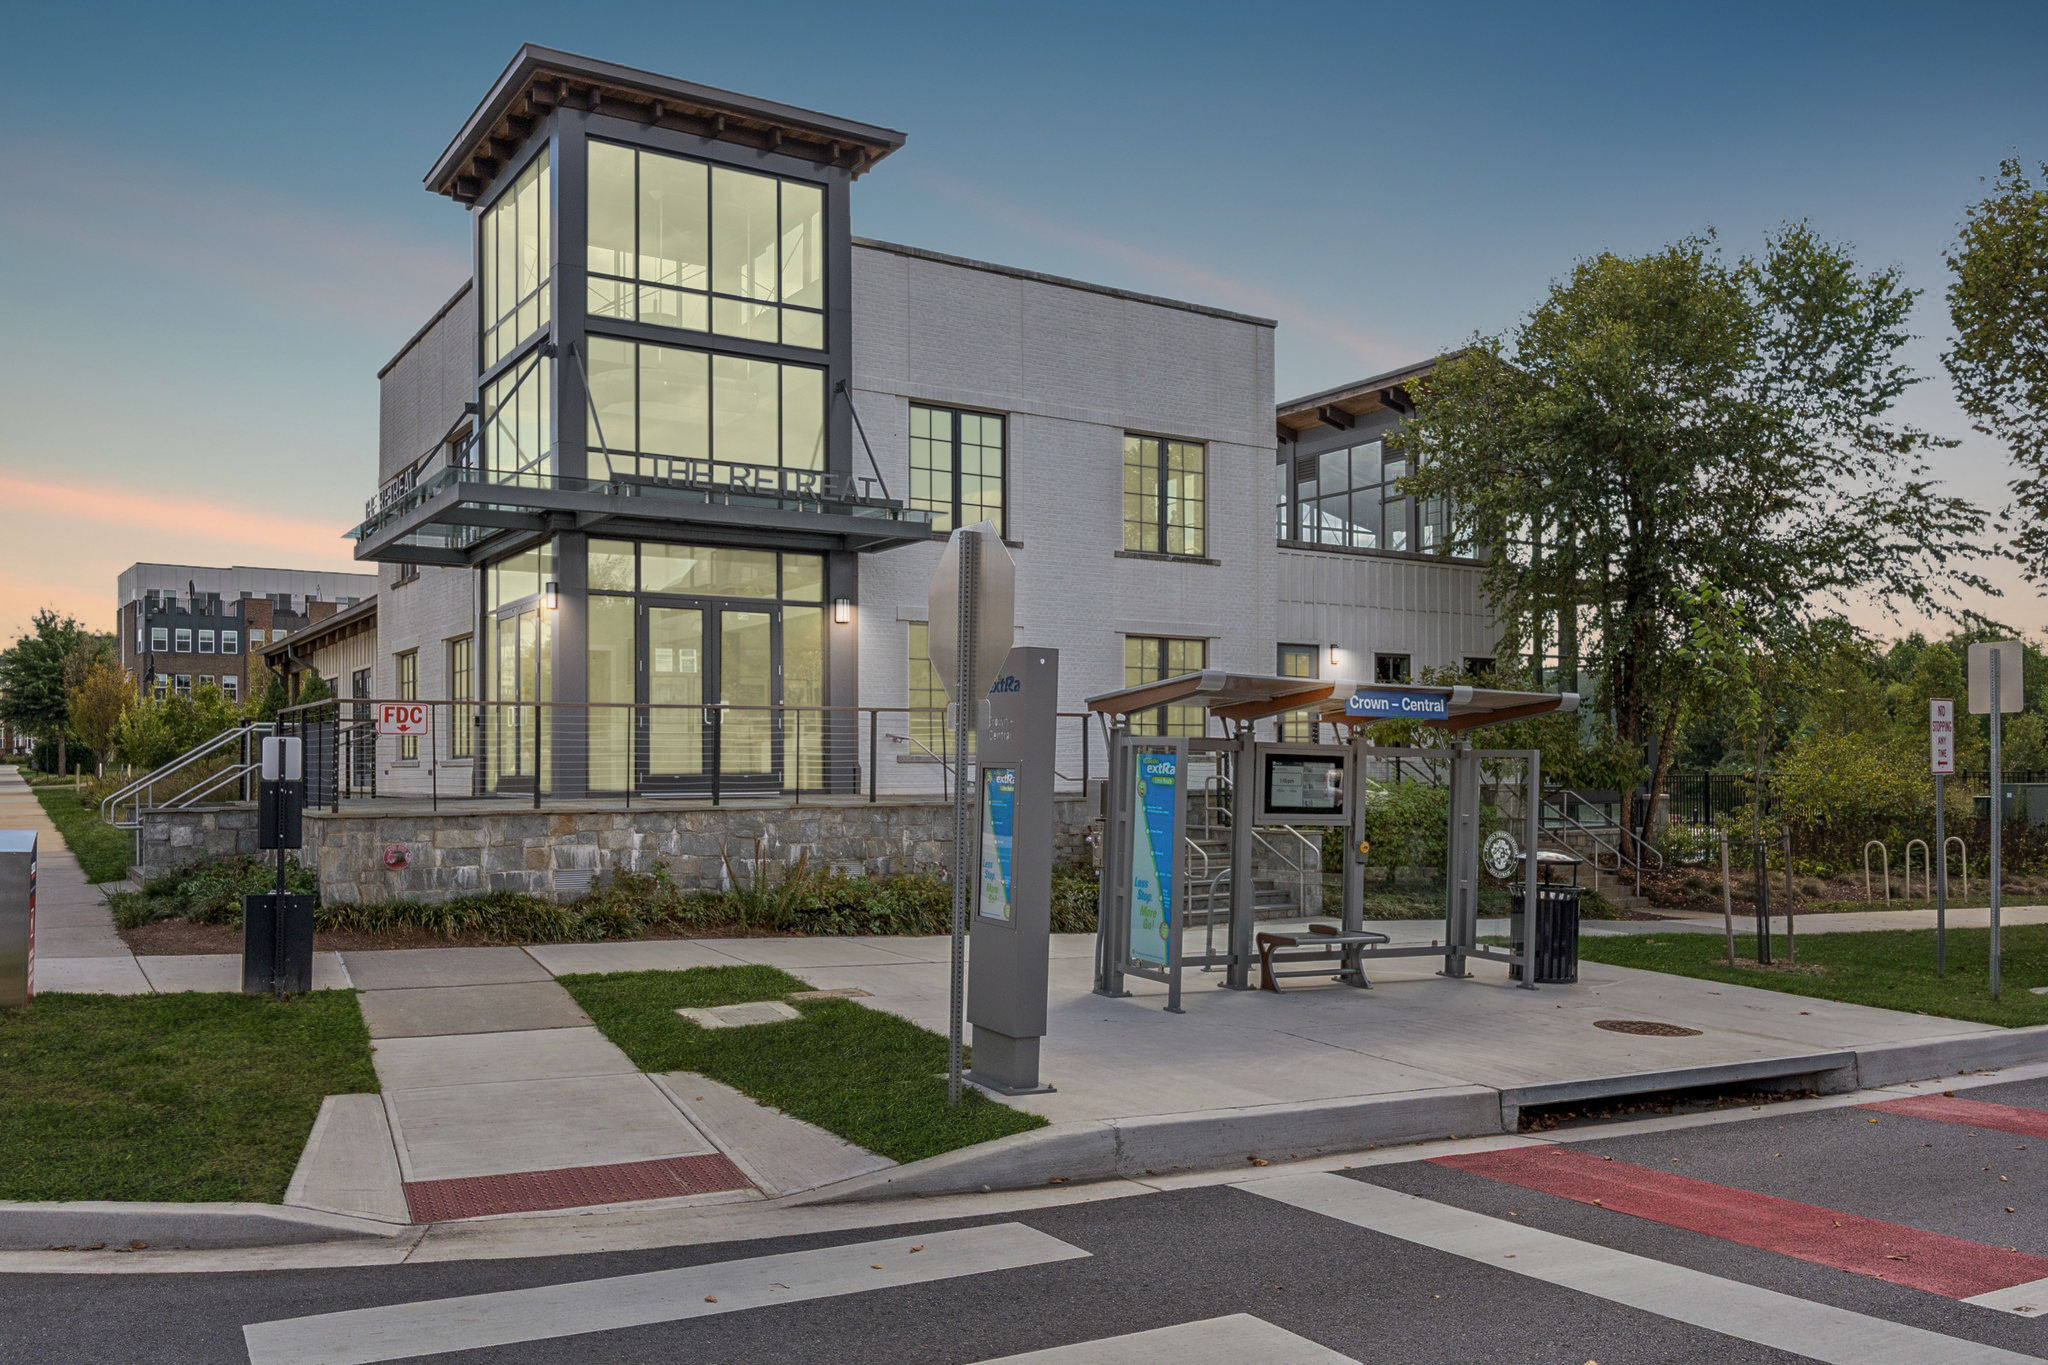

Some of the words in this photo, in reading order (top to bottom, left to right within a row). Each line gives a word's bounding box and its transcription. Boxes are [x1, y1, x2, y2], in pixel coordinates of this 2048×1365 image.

[644, 453, 713, 489] THE
[729, 463, 877, 504] RETREAT
[1349, 695, 1389, 710] Crown
[1401, 697, 1444, 712] Central
[384, 706, 422, 723] FDC
[1938, 705, 1946, 717] NO
[1932, 720, 1952, 732] STOPPING
[1938, 736, 1946, 745] ANY
[1937, 749, 1947, 758] TIME
